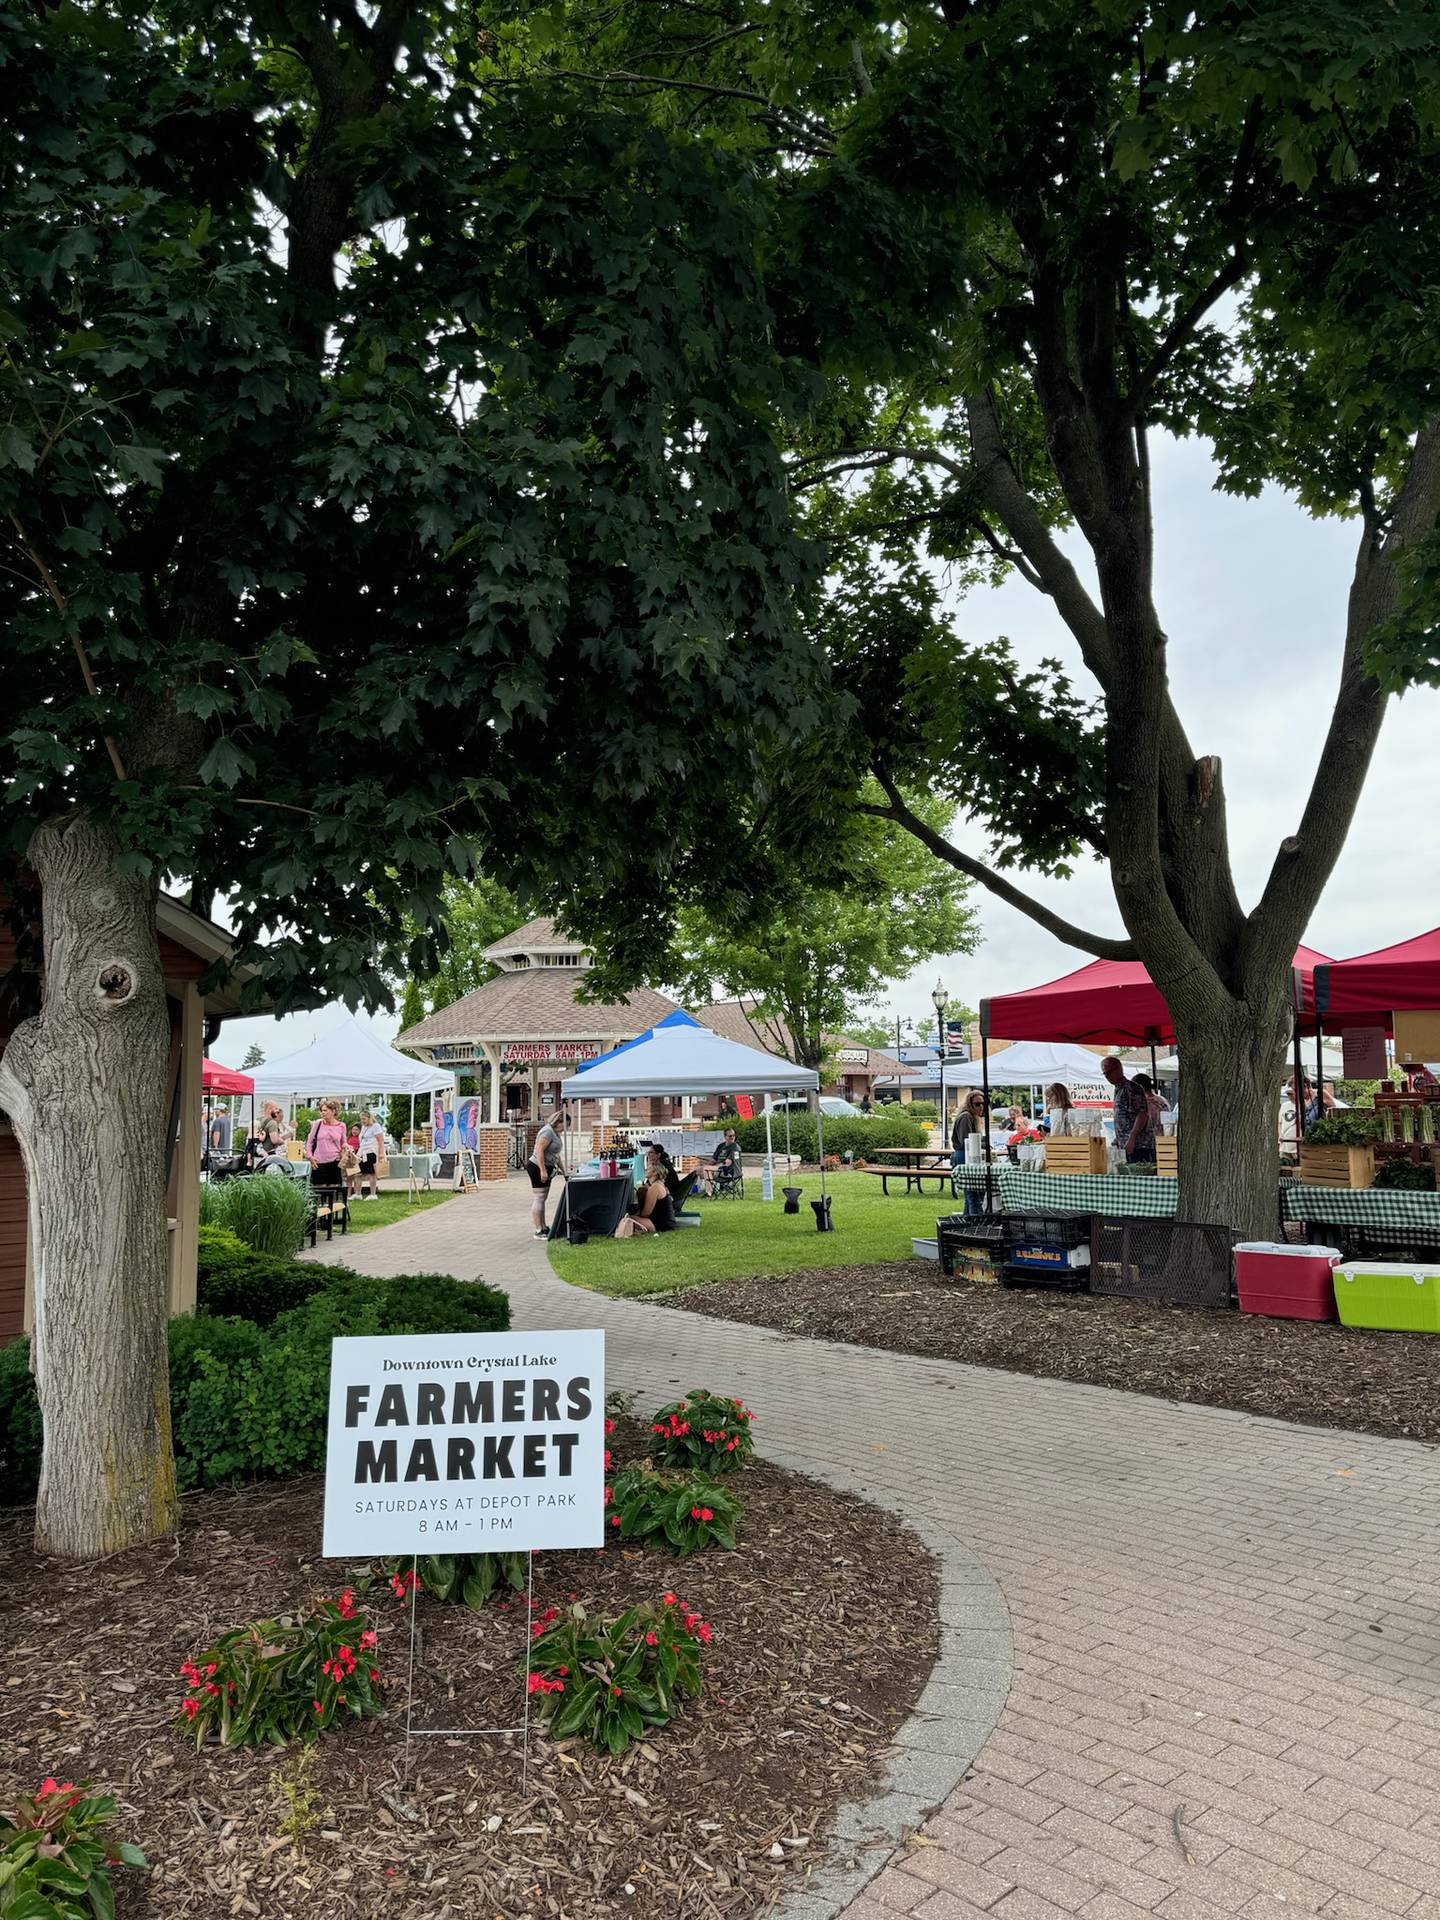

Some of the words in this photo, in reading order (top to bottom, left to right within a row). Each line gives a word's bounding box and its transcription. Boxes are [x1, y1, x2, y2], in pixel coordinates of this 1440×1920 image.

[383, 1359, 464, 1372] Downtown
[466, 1355, 520, 1374] Crystal
[522, 1354, 557, 1367] Lake
[344, 1376, 593, 1429] FARMERS
[353, 1432, 580, 1485] MARKET
[355, 1498, 448, 1514] SATURDAYS
[454, 1497, 474, 1510] AT
[480, 1495, 531, 1509] DEPOT
[537, 1493, 577, 1507] PARK
[418, 1519, 428, 1533] 8
[434, 1519, 459, 1532] AM
[479, 1517, 485, 1530] 1
[491, 1517, 513, 1530] PM
